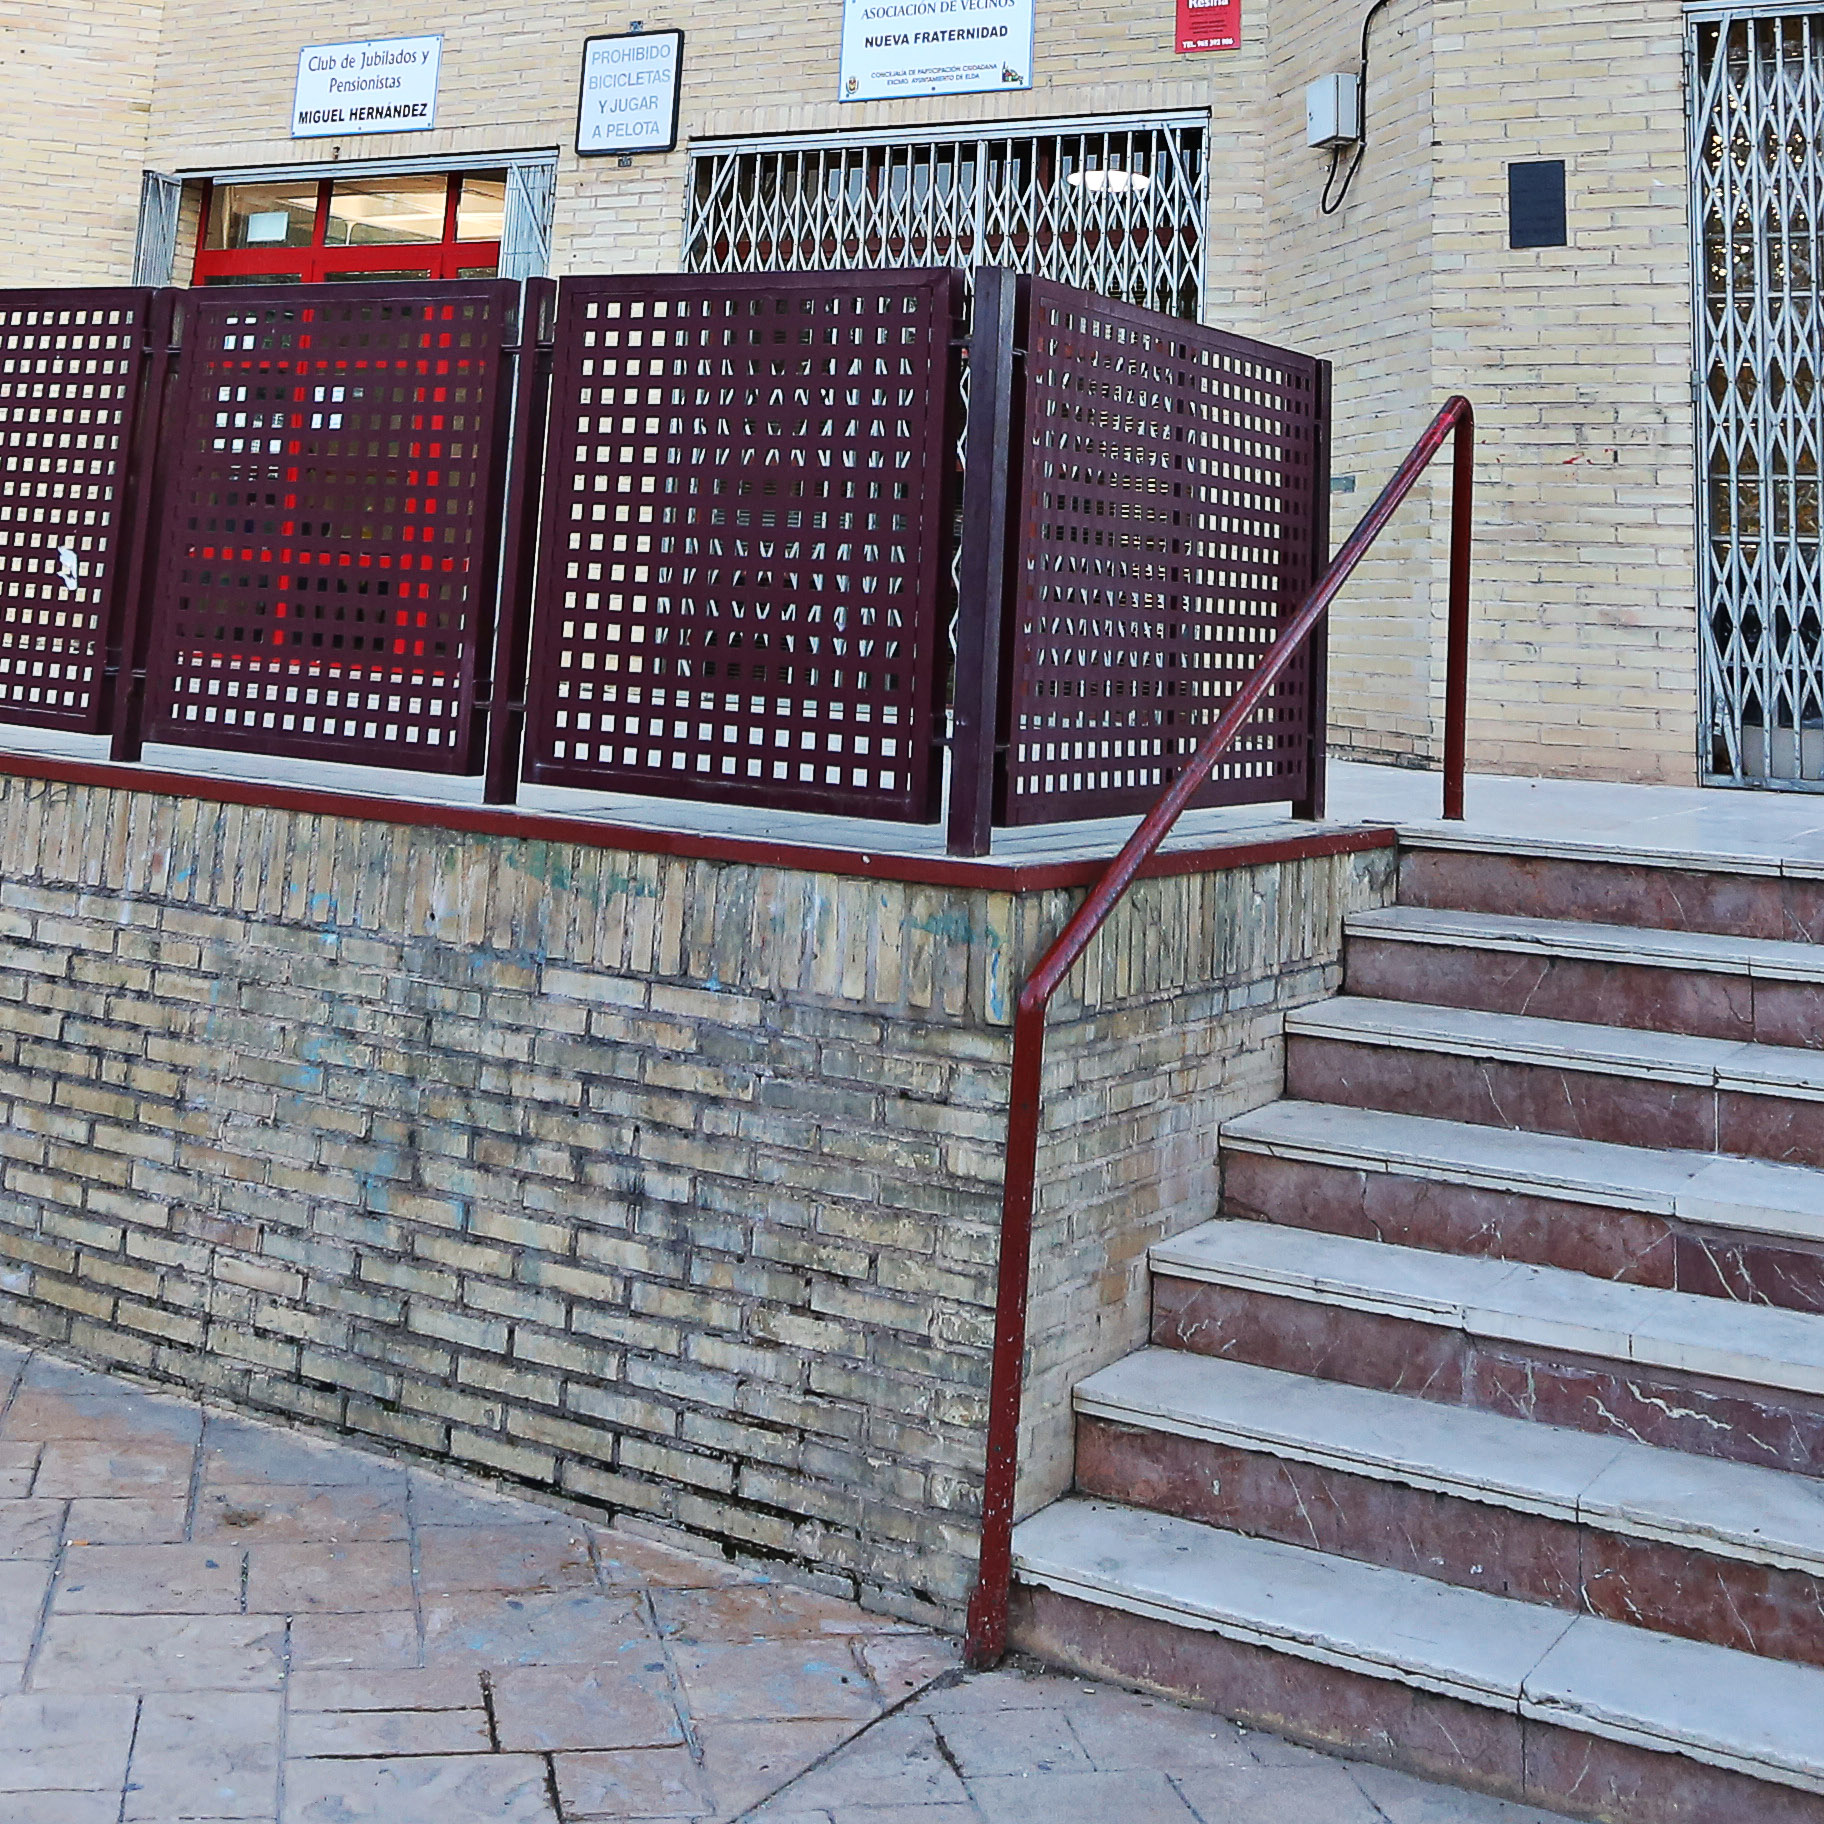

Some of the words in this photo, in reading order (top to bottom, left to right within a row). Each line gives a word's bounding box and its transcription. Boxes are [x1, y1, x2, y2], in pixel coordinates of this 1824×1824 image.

[861, 0, 936, 20] ASOCIACIÓN
[941, 0, 957, 13] DE
[864, 33, 909, 48] NUEVA
[914, 25, 1008, 44] FRATERNIDAD
[308, 55, 336, 72] Club
[341, 54, 356, 69] de
[360, 49, 417, 70] Jubilados
[421, 50, 430, 64] y
[592, 44, 671, 65] PROHIBIDO
[329, 75, 402, 93] Pensionistas
[589, 69, 671, 89] BICICLETAS
[298, 108, 345, 125] MIGUEL
[349, 101, 428, 122] HERNÁNDEZ
[598, 100, 607, 114] Y
[610, 95, 659, 113] JUGAR
[592, 125, 601, 139] A
[606, 121, 660, 138] PELOTA
